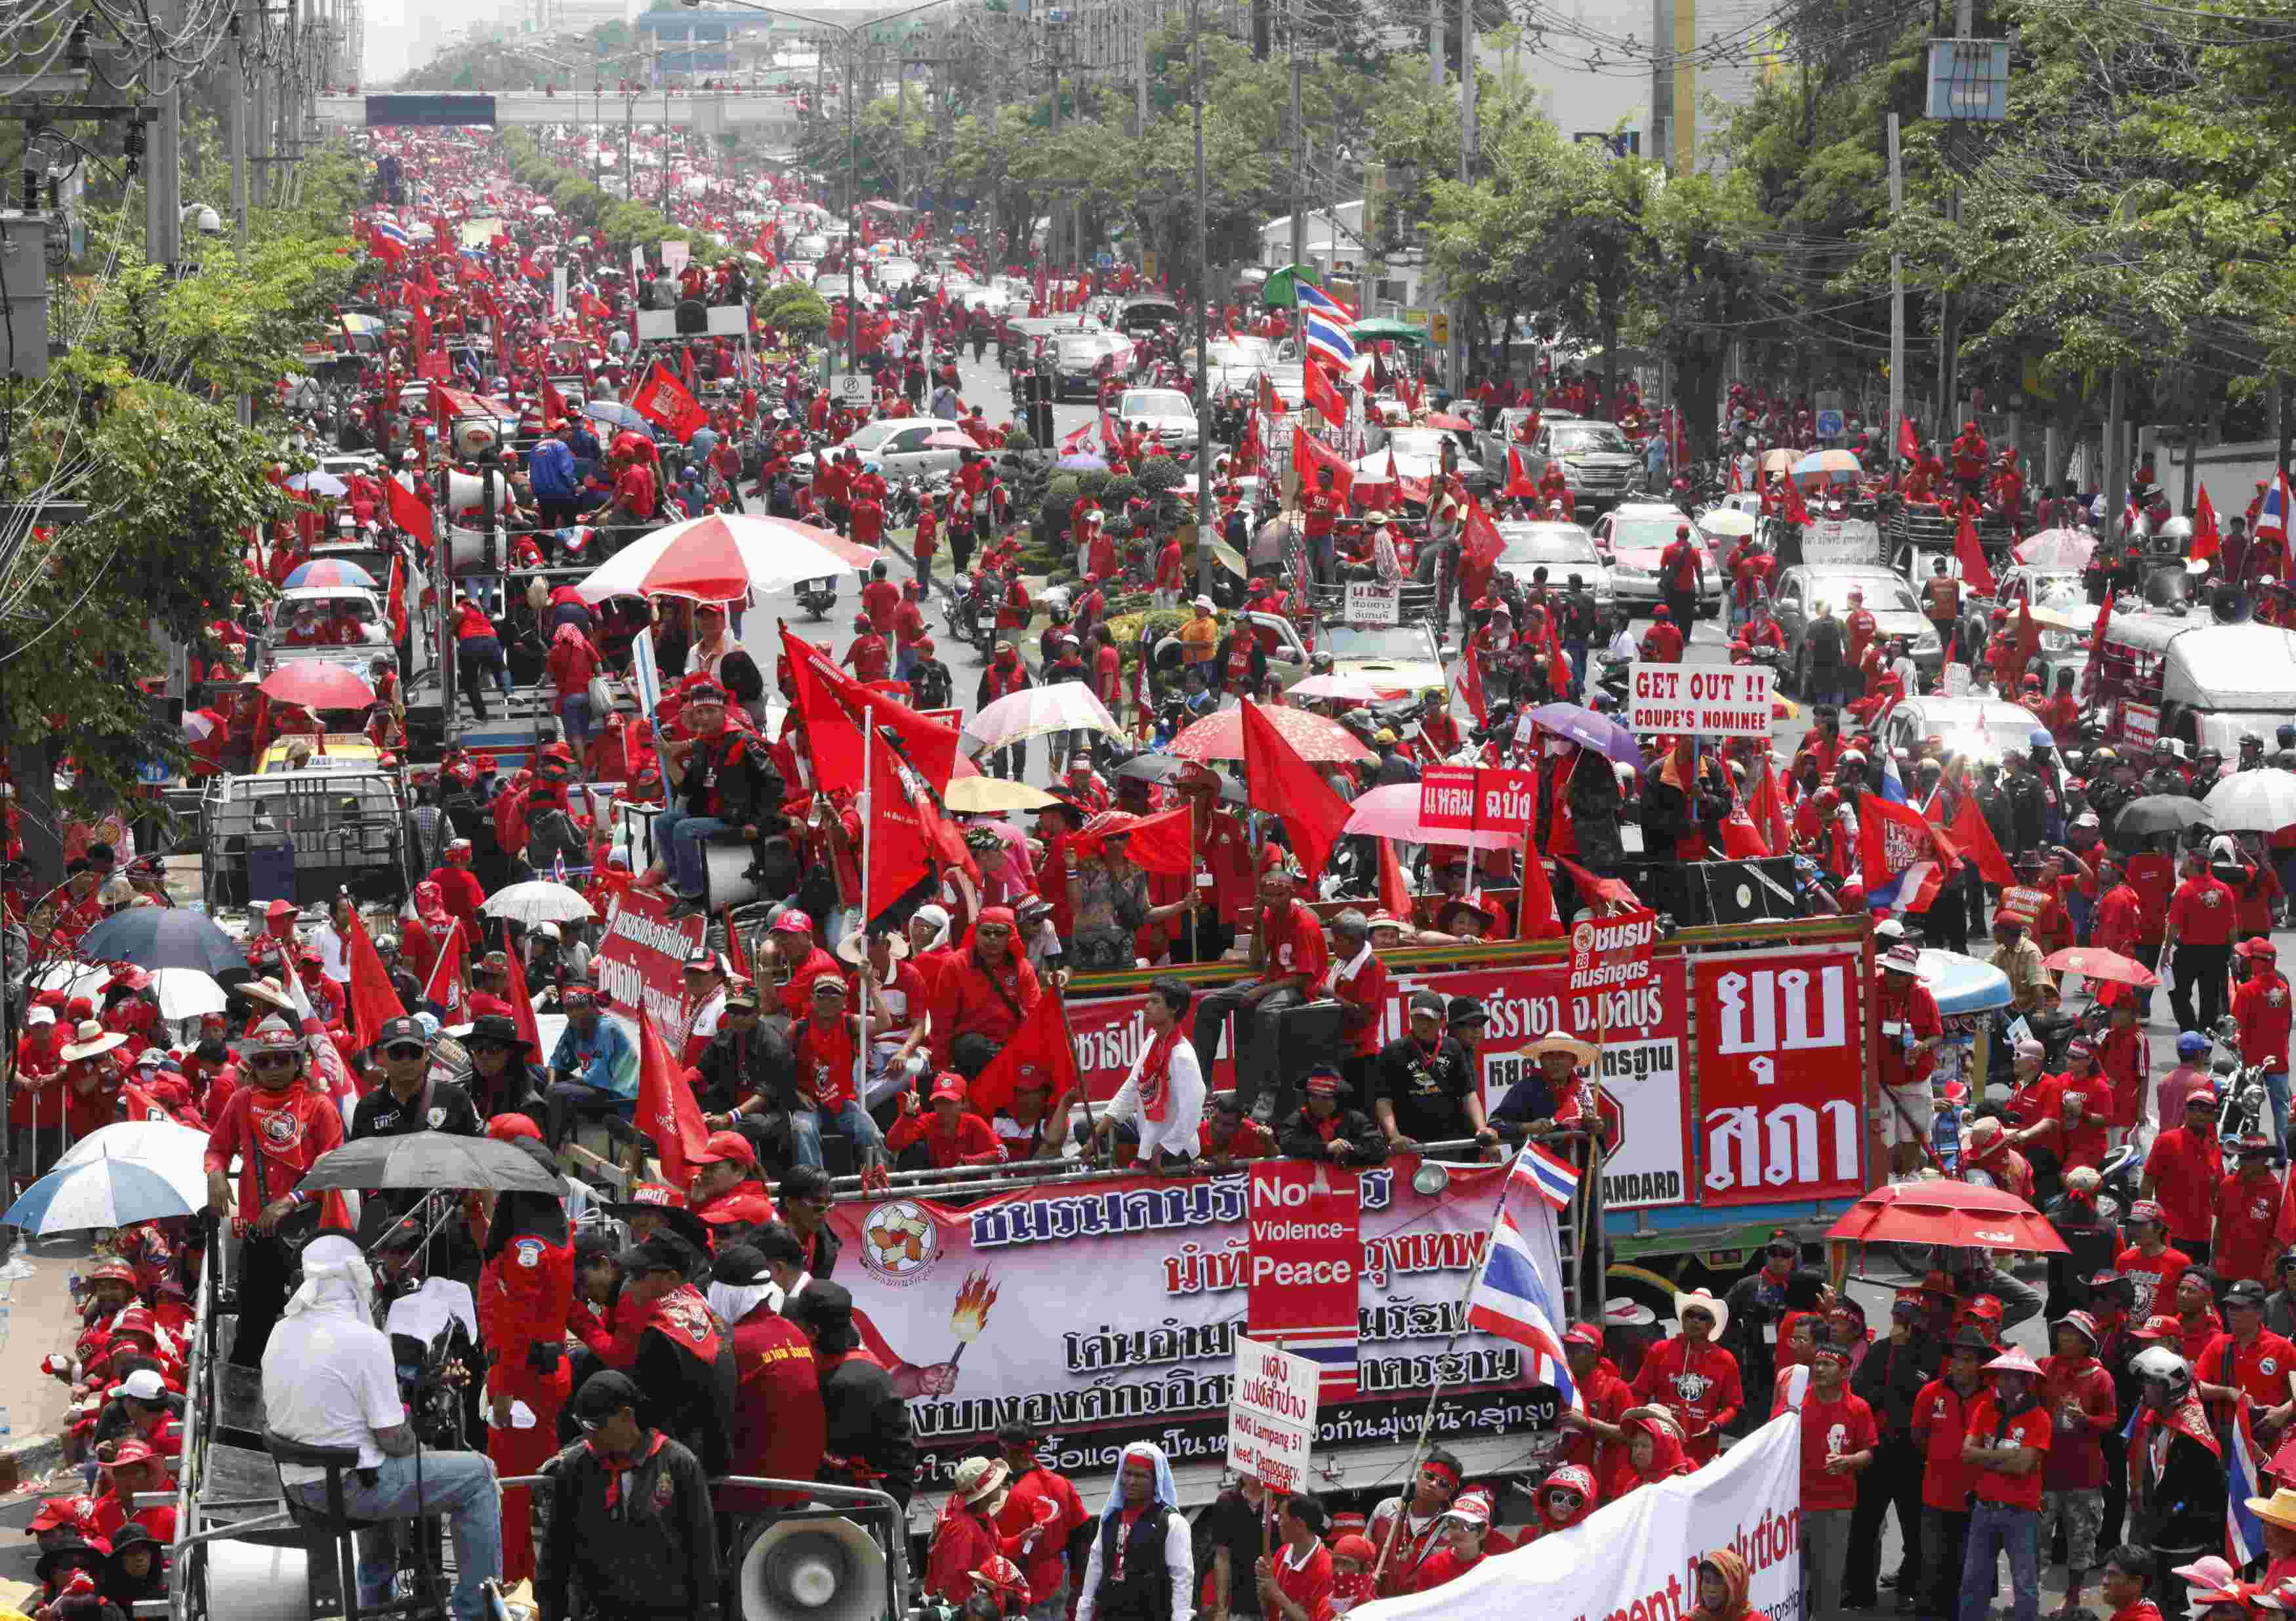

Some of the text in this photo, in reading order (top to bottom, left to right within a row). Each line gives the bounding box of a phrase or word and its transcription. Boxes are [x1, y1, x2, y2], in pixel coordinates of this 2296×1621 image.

[1637, 672, 1764, 701] GET OUT !!
[1635, 709, 1765, 729] COUPE'S NOMINEE
[1424, 780, 1530, 819] แหลม ฉบัง
[1595, 920, 1652, 951] ชมรม
[1570, 960, 1649, 989] คนรักอุดร
[1717, 965, 1846, 1084] ยุบ
[1704, 1099, 1858, 1191] สภา
[1603, 1170, 1680, 1206] ANDARD
[1253, 1256, 1351, 1286] Peace
[1235, 1413, 1251, 1435] HUG
[1253, 1418, 1289, 1453] Lampang
[1233, 1441, 1254, 1465] Need!
